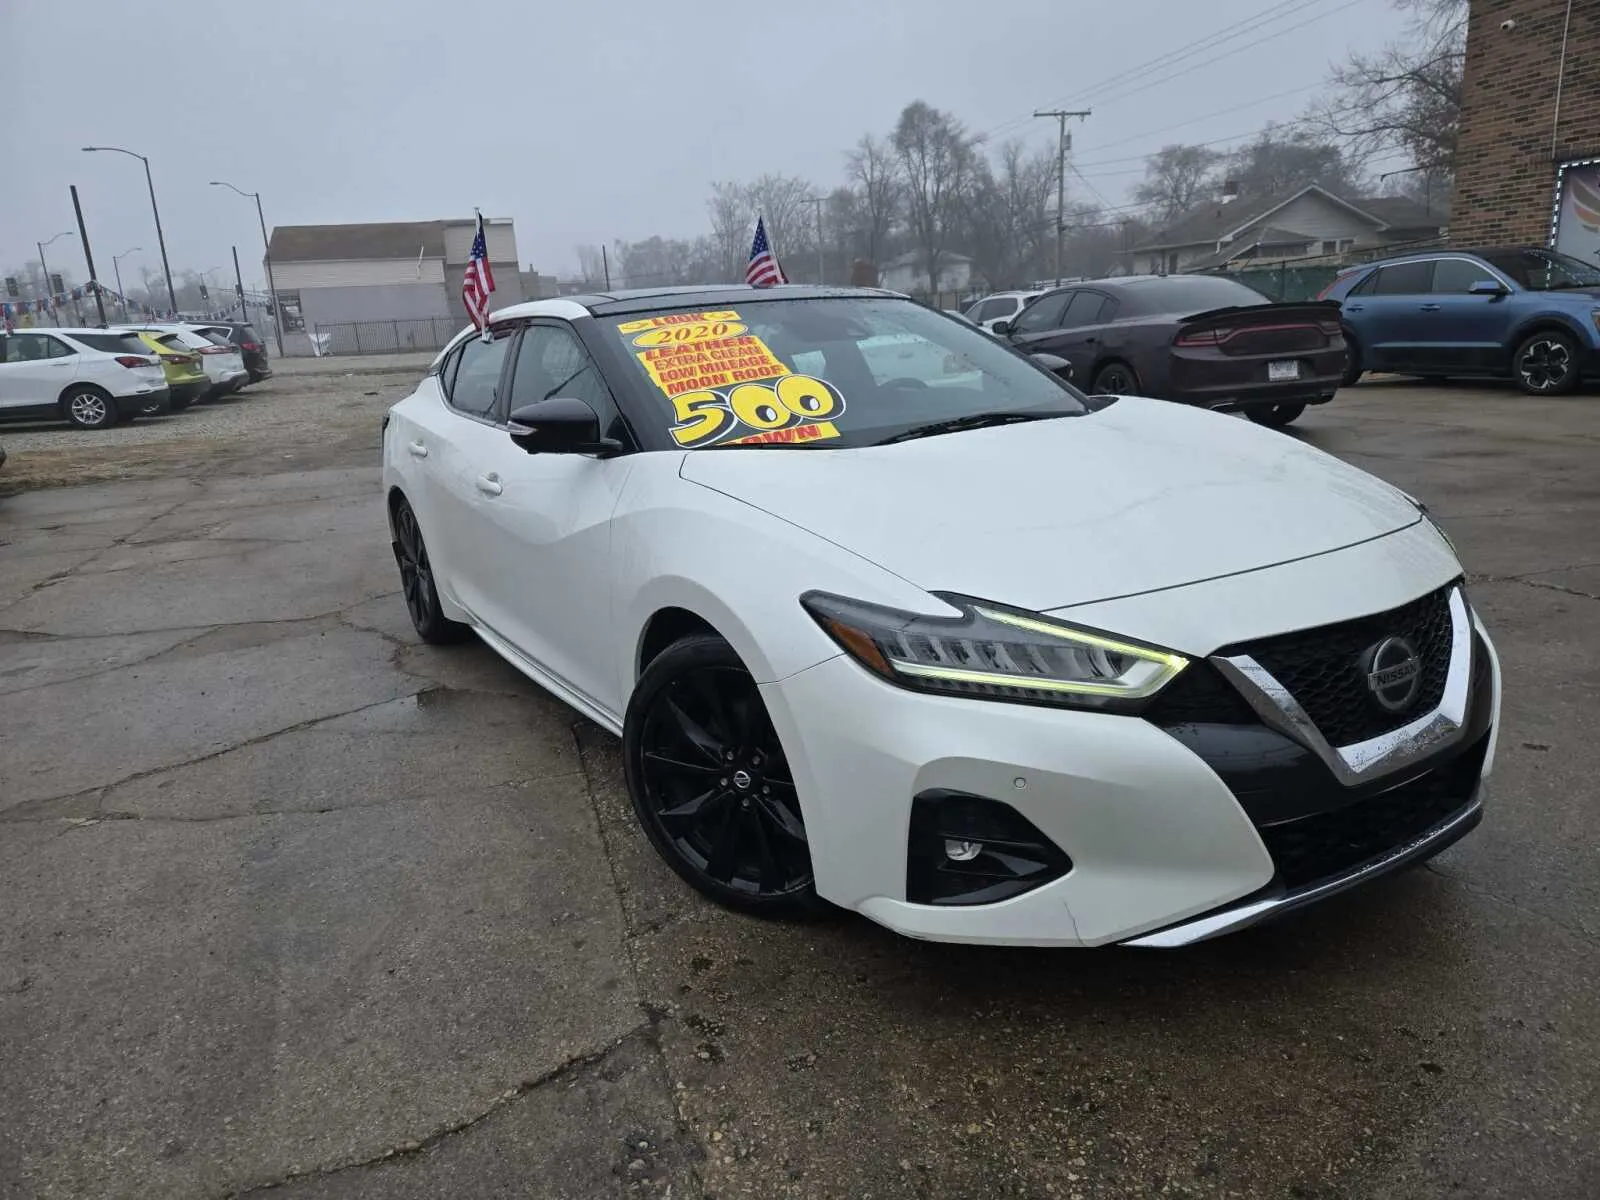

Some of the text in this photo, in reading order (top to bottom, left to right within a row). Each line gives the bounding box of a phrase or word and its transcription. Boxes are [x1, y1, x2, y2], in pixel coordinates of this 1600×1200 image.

[651, 313, 705, 327] LOOK
[656, 322, 729, 345] 2020
[645, 336, 756, 361] LEATHER
[653, 345, 762, 371] EXTRA CLEAN
[659, 354, 771, 383] LOW MILEAGE
[667, 365, 786, 396] MOON ROOF
[668, 374, 847, 448] 500
[735, 424, 820, 444] OWN
[1377, 661, 1417, 685] NISSAN
